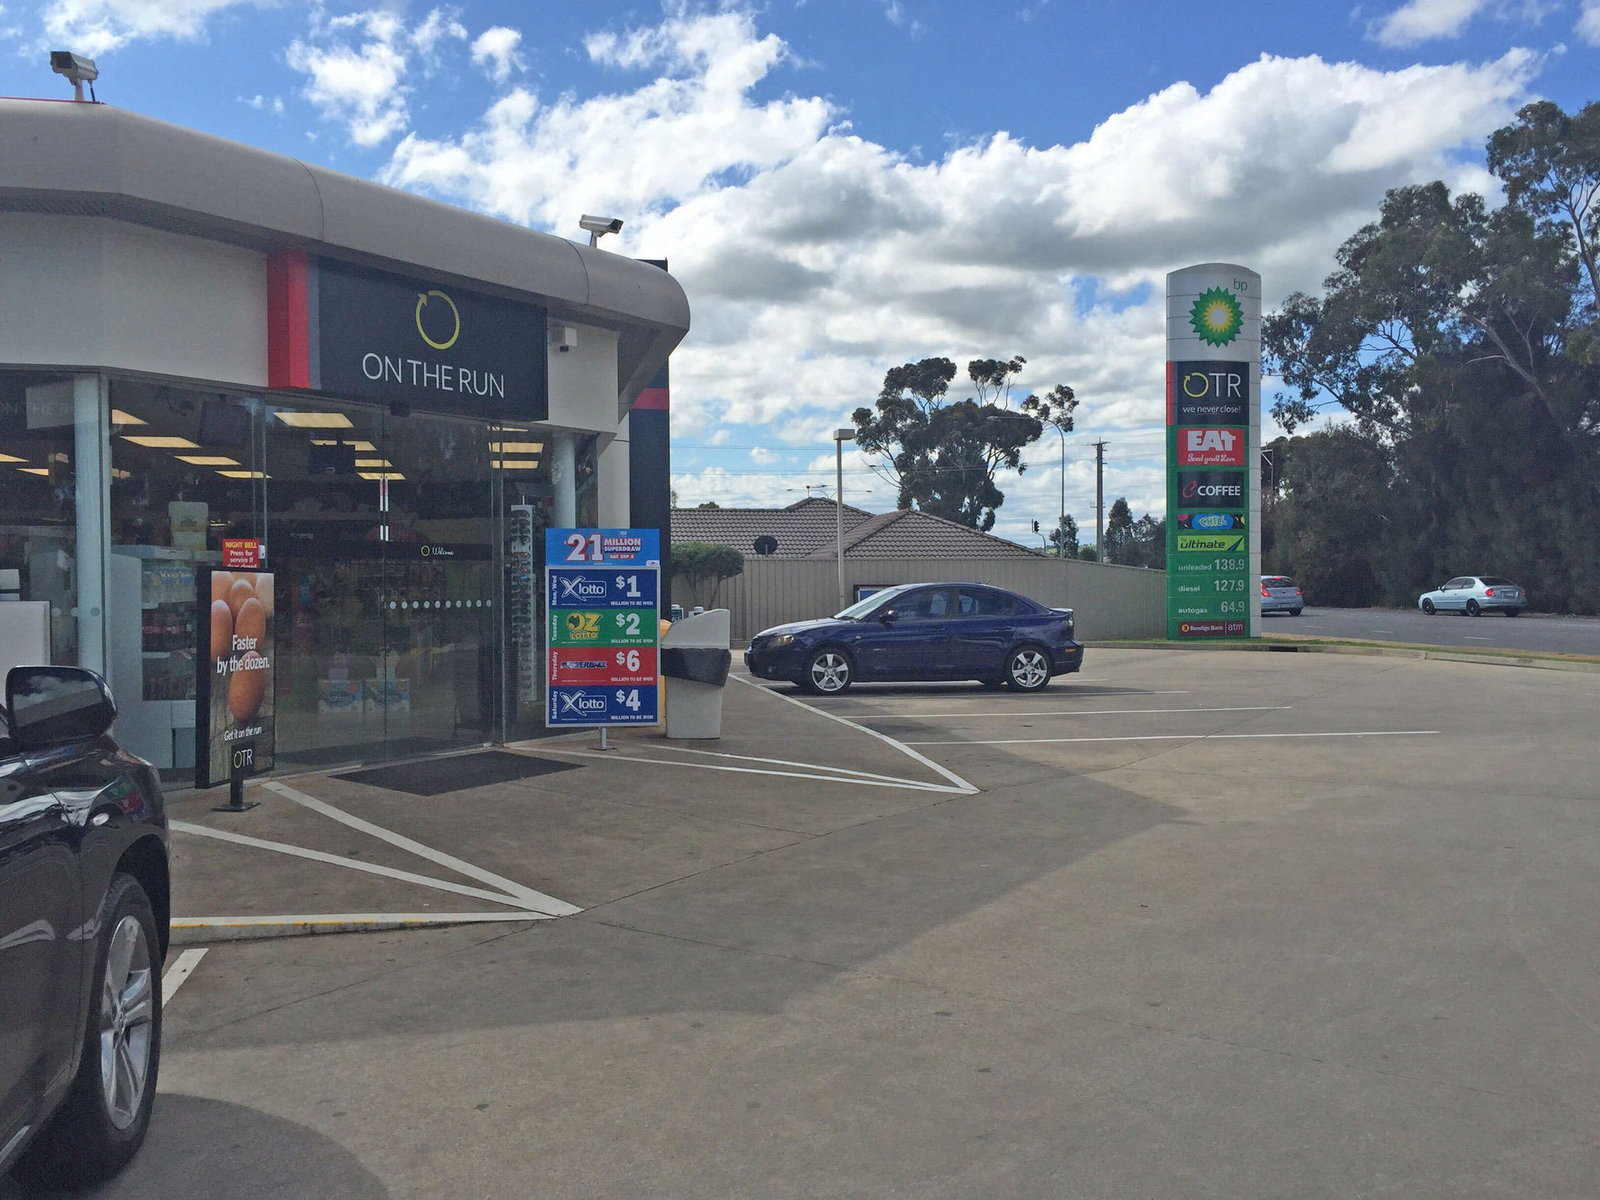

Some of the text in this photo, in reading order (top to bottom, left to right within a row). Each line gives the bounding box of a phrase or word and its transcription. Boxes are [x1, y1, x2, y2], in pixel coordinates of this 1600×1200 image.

[1233, 278, 1248, 293] bp
[362, 352, 505, 399] ON THE RUN
[1183, 372, 1241, 398] OTR
[1220, 405, 1241, 413] close!
[1187, 430, 1237, 452] EAT
[1197, 485, 1241, 496] COFFEE
[566, 534, 641, 561] 21 MILLION
[1180, 540, 1226, 549] ultimate
[1178, 559, 1245, 571] unleaded 138.9
[616, 575, 641, 598] $1
[1214, 579, 1245, 591] 127.9
[1178, 601, 1245, 616] autogas 64.9
[551, 614, 559, 641] Tuesday
[566, 612, 603, 632] OZ
[616, 613, 640, 635] $2
[1227, 623, 1243, 631] atm
[232, 634, 257, 651] Faster
[570, 632, 599, 640] LOTTO
[217, 655, 270, 676] by the dozen.
[551, 651, 559, 680] Thursday
[616, 649, 640, 672] $6
[551, 690, 559, 719] Saturday
[616, 689, 641, 711] $4
[224, 726, 262, 741] Get it on the run
[233, 748, 253, 769] OTR
